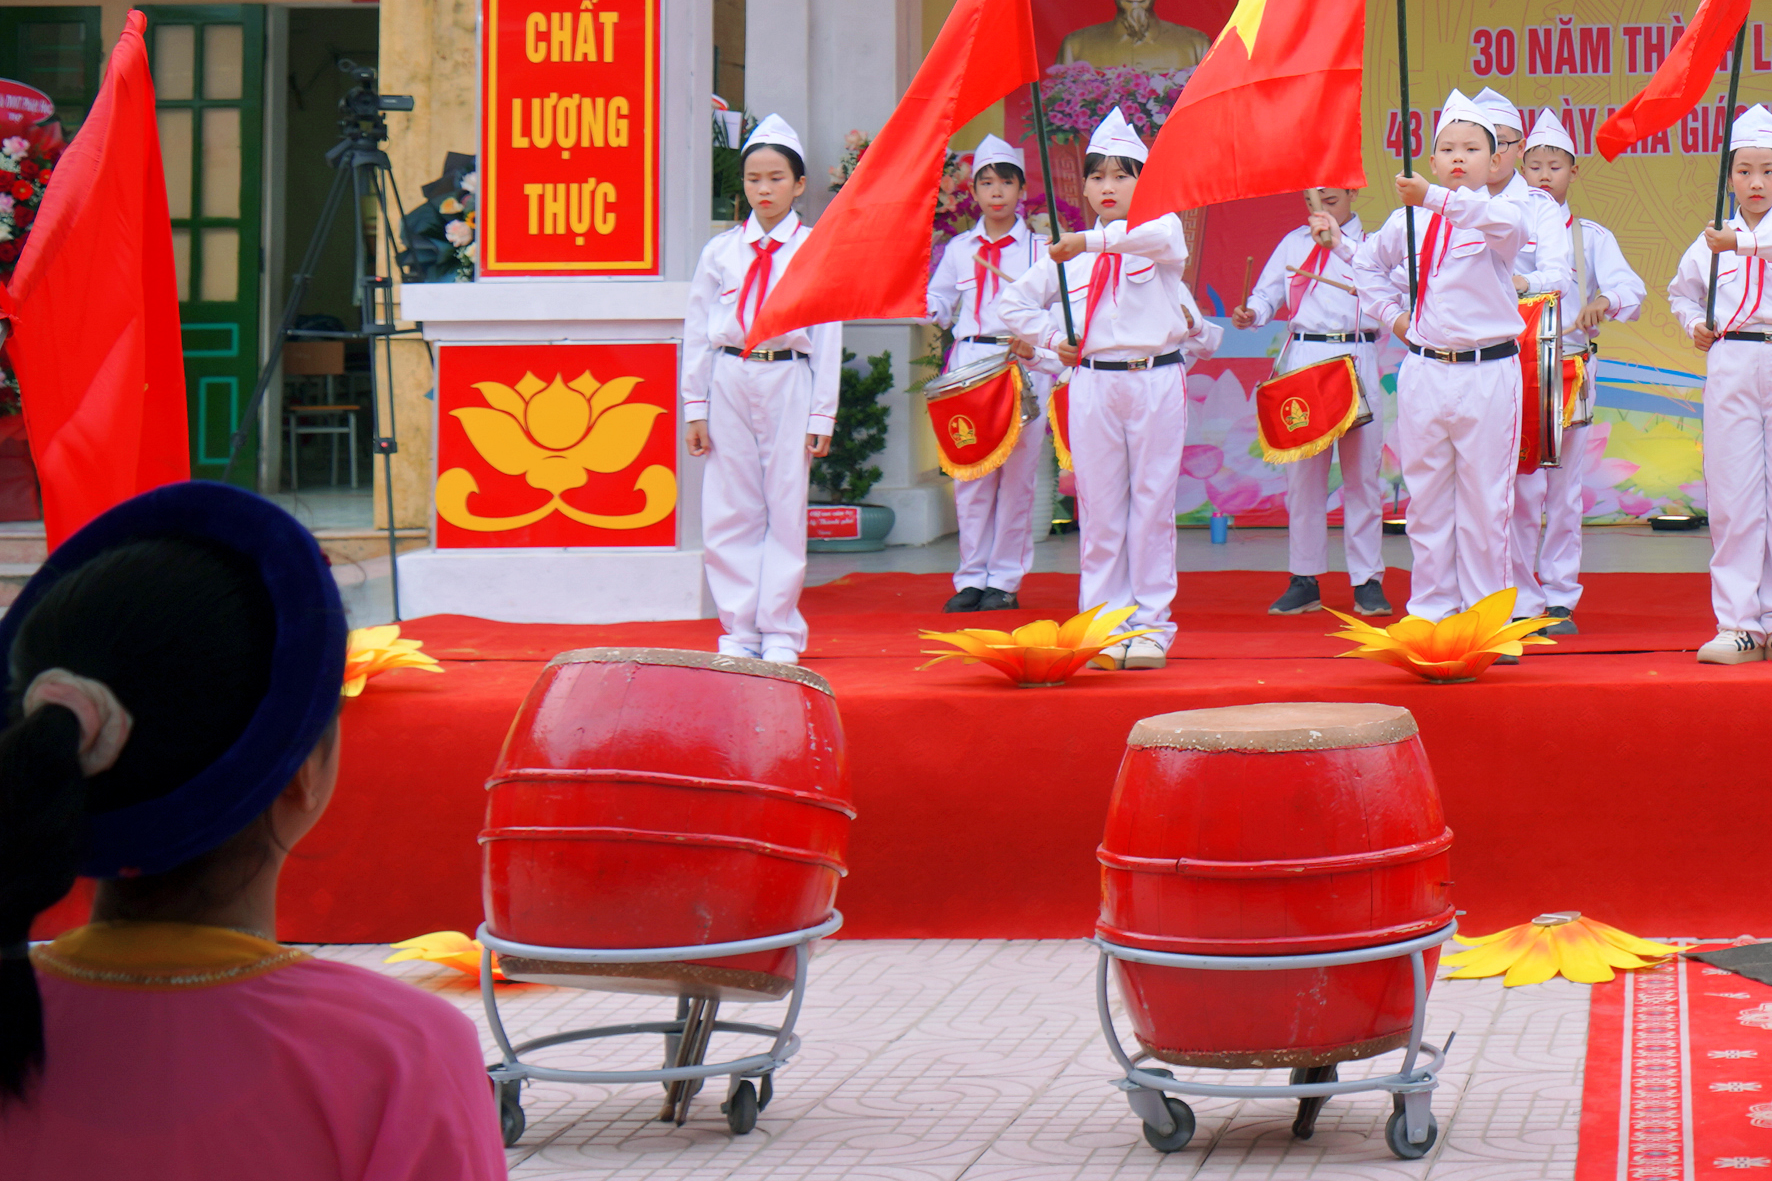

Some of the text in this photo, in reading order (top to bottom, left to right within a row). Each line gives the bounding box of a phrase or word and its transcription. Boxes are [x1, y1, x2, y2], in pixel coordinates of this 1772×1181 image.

[1473, 28, 1515, 76] 30
[1528, 17, 1611, 75] NĂM
[511, 92, 630, 159] LƯỢNG
[1386, 110, 1422, 158] 43
[523, 177, 617, 246] THỰC
